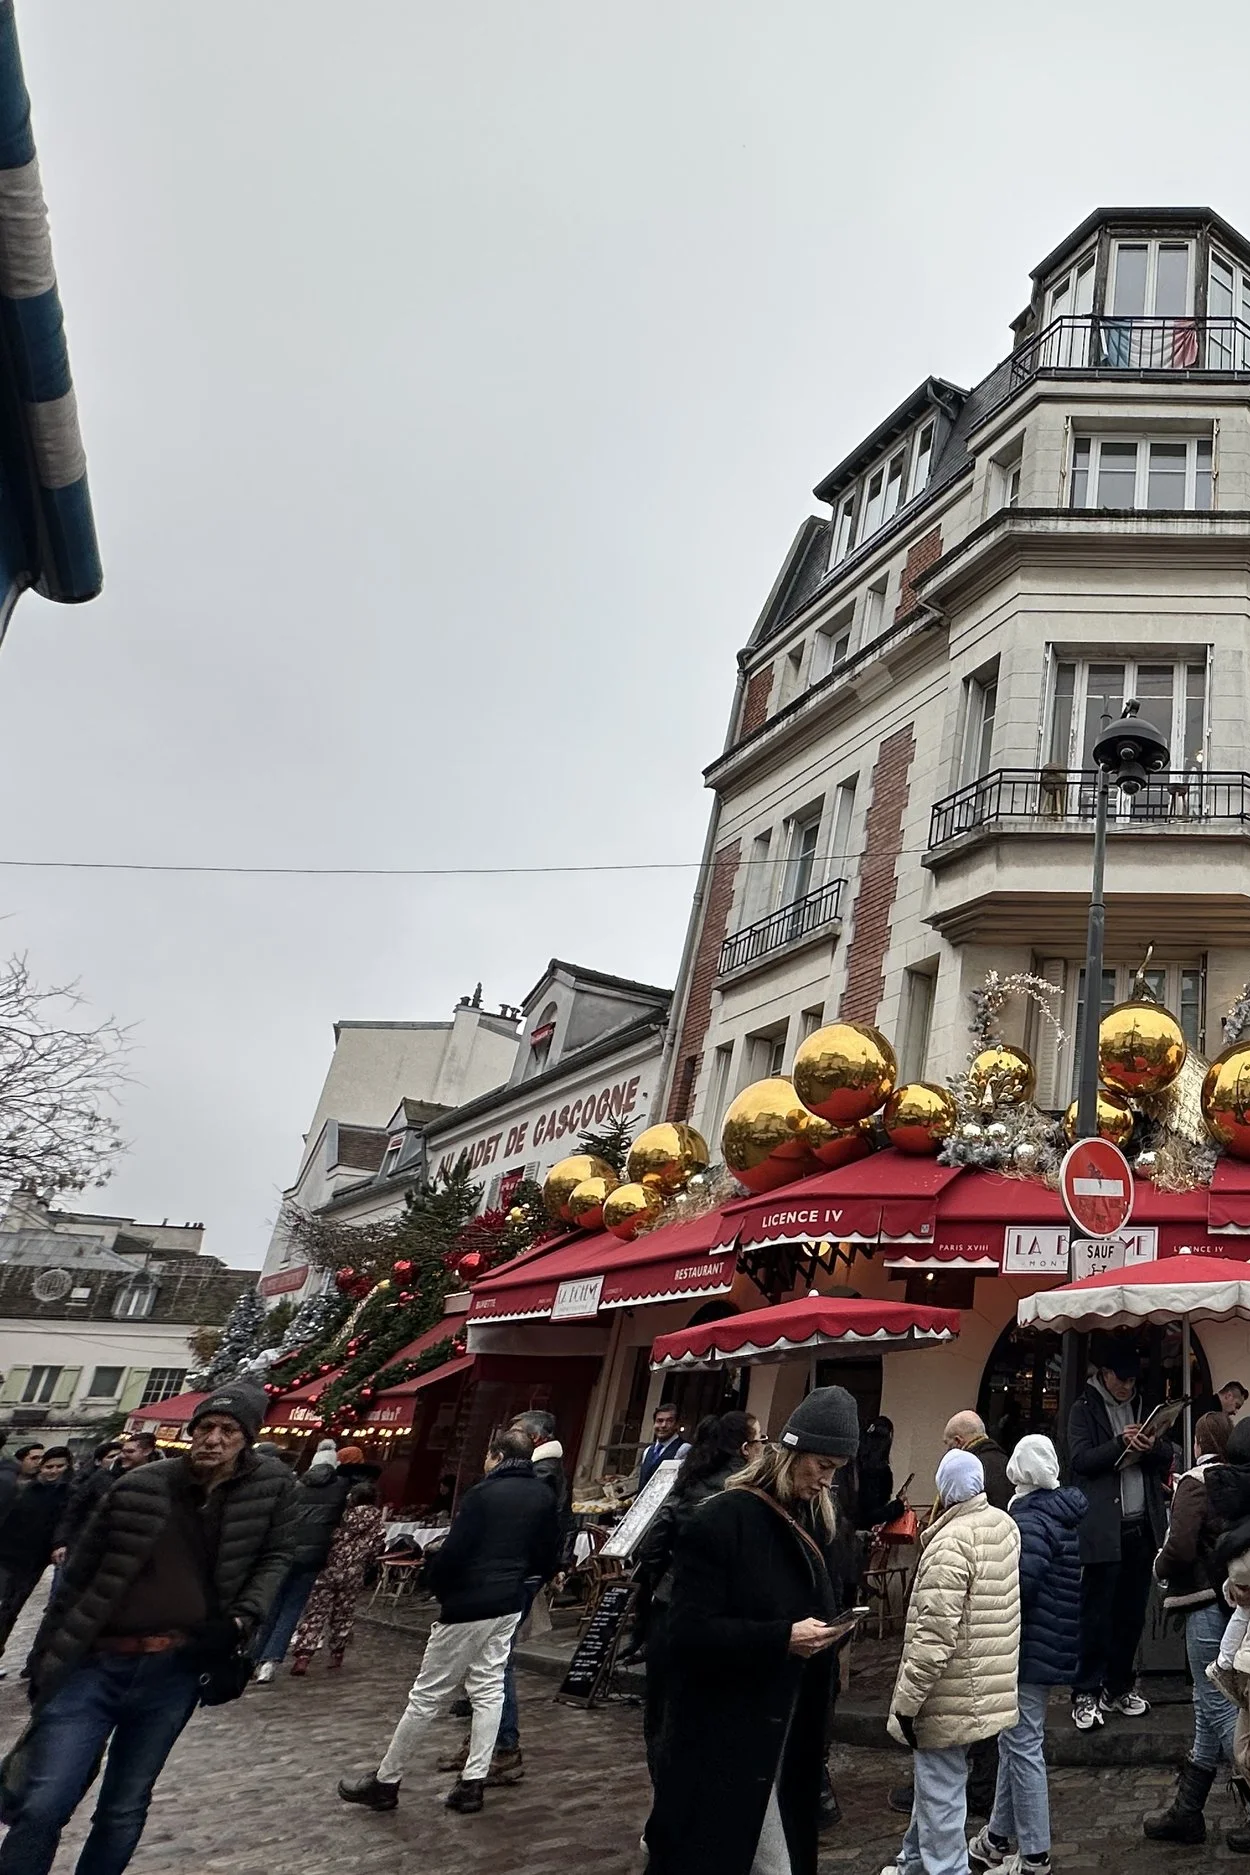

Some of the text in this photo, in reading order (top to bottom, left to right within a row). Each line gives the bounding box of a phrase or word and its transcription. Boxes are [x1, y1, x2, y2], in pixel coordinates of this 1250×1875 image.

[503, 1121, 530, 1159] DE
[532, 1075, 641, 1148] GASCOGNE
[761, 1209, 843, 1229] LICENCE IV
[939, 1244, 989, 1252] PARIS XVIII
[1015, 1234, 1042, 1256] LA
[1087, 1244, 1115, 1259] SAUF
[1214, 1245, 1224, 1253] IV
[674, 1262, 725, 1281] RESTAURANT
